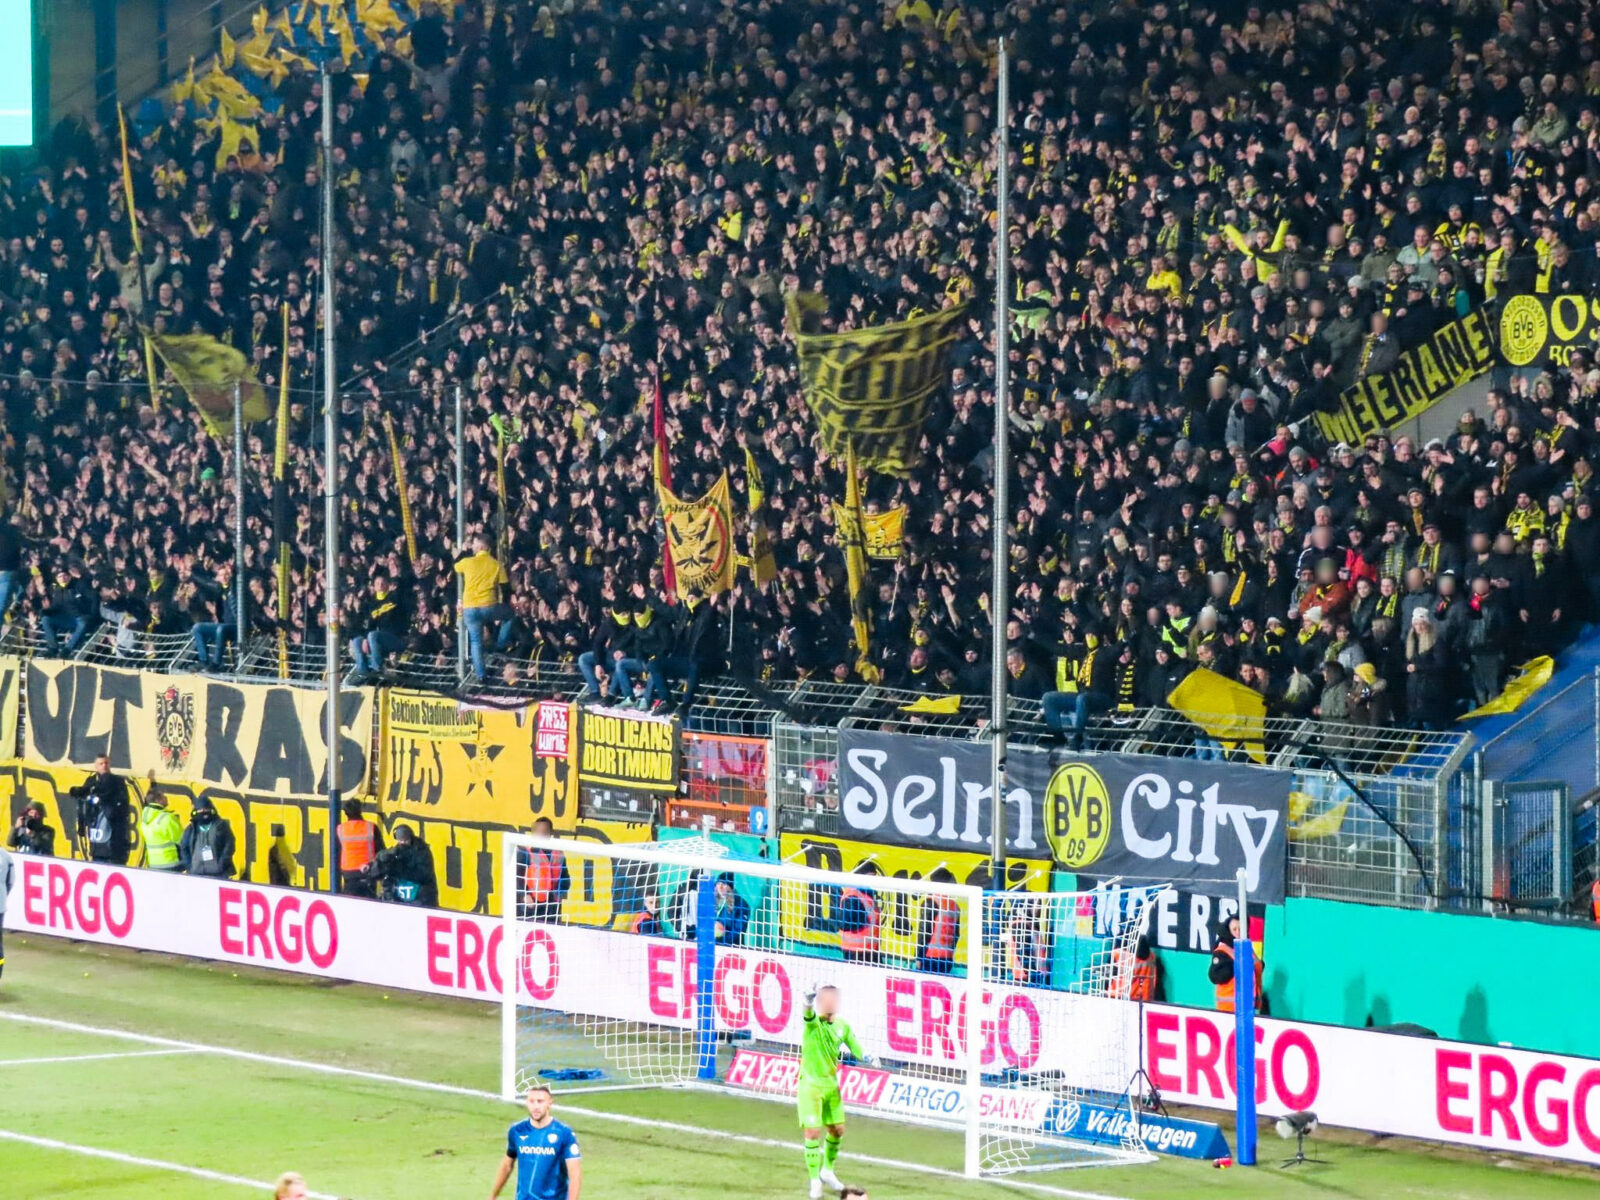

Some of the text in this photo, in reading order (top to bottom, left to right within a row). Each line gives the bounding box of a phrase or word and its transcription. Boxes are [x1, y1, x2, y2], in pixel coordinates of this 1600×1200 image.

[582, 742, 673, 781] DORTMUND
[583, 713, 674, 752] HOOLIGANS
[754, 810, 764, 830] 9
[1054, 774, 1103, 841] BVB
[1121, 773, 1279, 893] City
[1066, 837, 1087, 860] 09
[23, 860, 135, 939] ERGO
[218, 886, 339, 969] ERGO
[427, 915, 560, 1001] ERGO
[886, 975, 1042, 1070] ERGO
[730, 1051, 884, 1102] FLYERRM
[1146, 1010, 1321, 1112] ERGO
[1086, 1109, 1198, 1150] Volkswagen
[1435, 1047, 1600, 1156] ERGO
